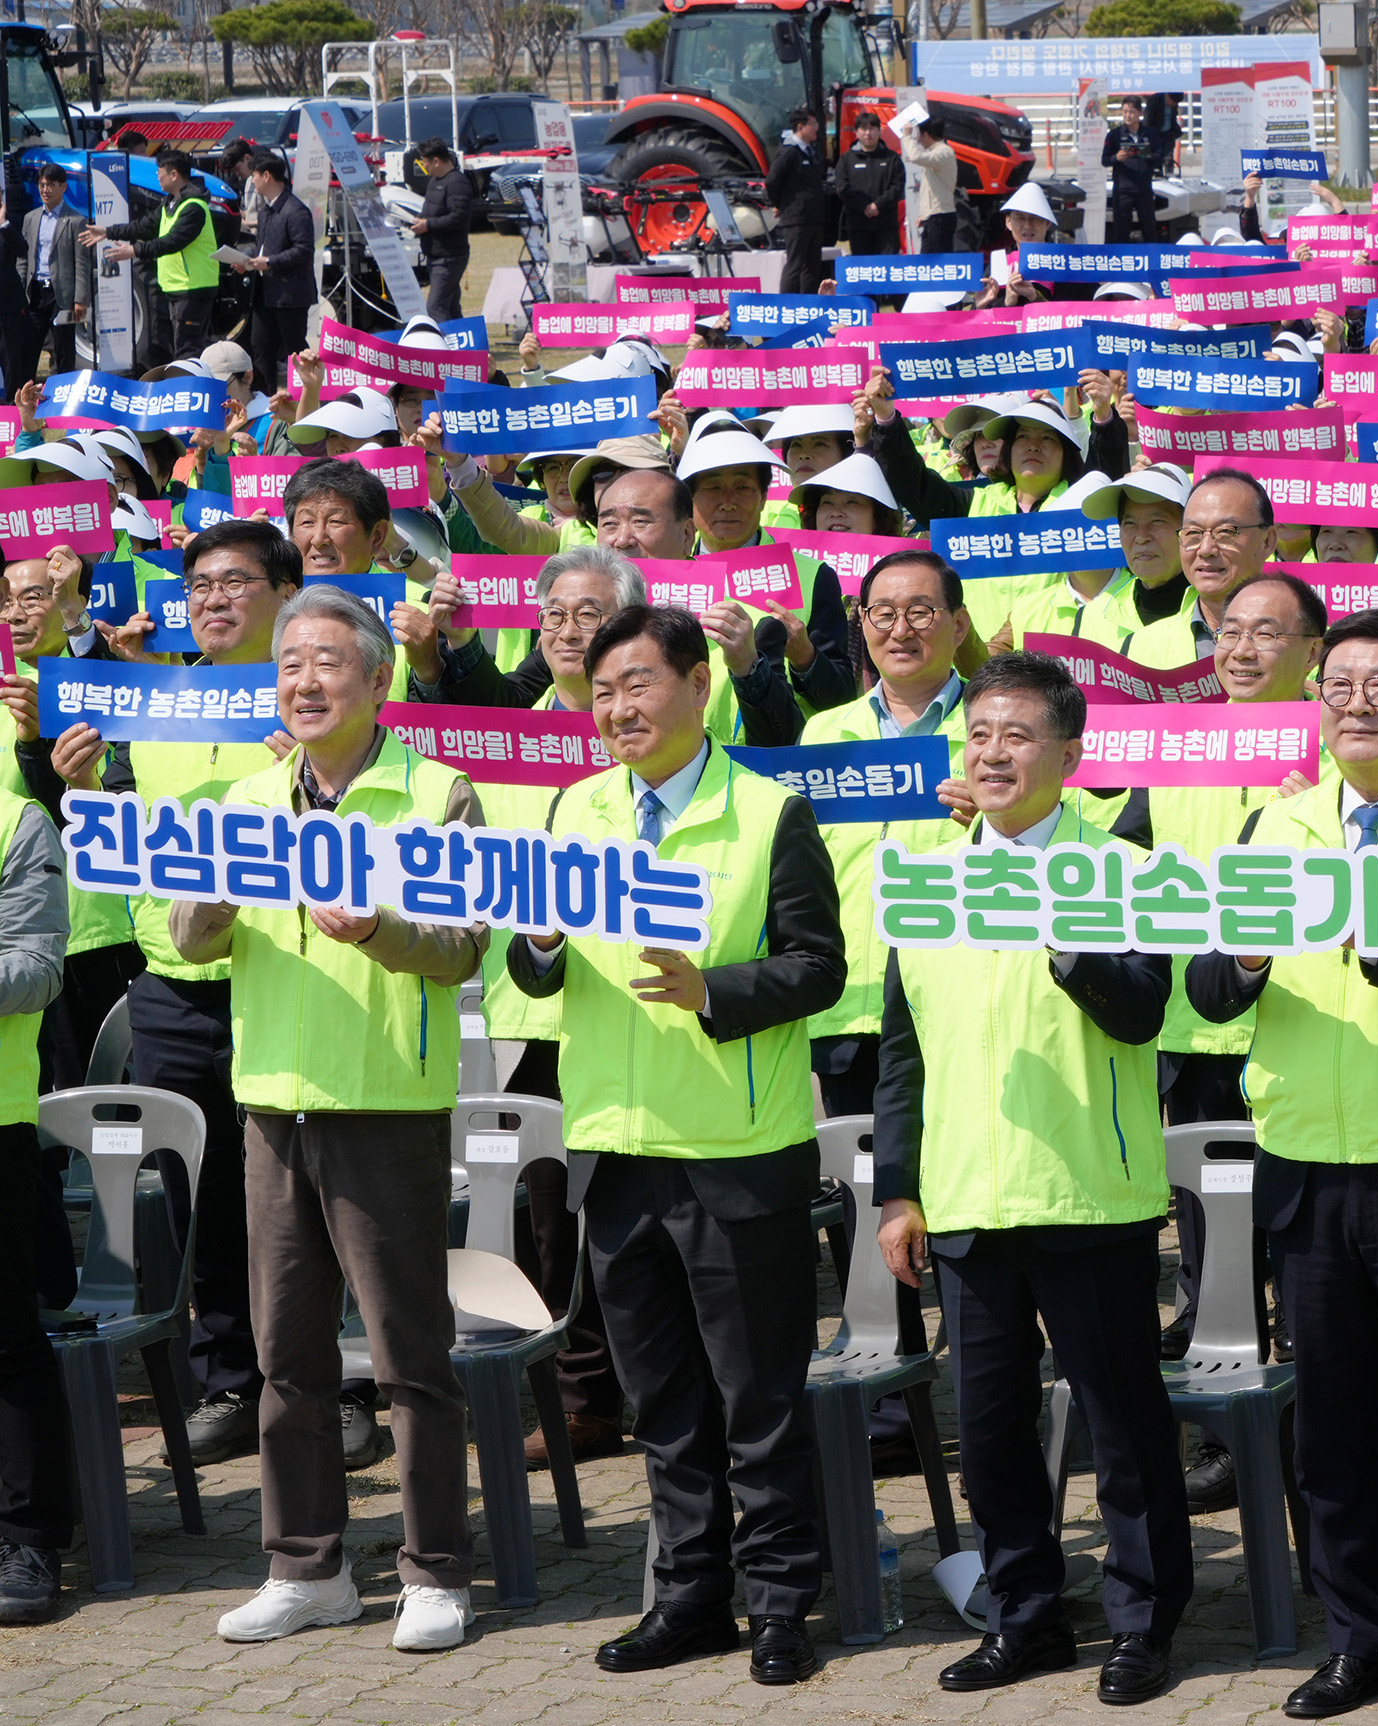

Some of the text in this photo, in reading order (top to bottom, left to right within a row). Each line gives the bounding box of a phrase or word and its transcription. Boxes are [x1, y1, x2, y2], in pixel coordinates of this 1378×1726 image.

[1213, 105, 1240, 114] RT100
[1268, 99, 1297, 108] RT100
[1263, 157, 1318, 171] 농촌일손돕기
[95, 200, 114, 216] MT7
[846, 265, 971, 282] 행복한 농촌일손돕기
[1027, 254, 1148, 271] 행복한 농촌일손돕기
[1174, 283, 1336, 312] 농업에 희망을! 농촌에 행복을!
[539, 317, 571, 333] 농업에
[574, 317, 613, 333] 희망을!
[654, 314, 689, 332] 행복을!
[737, 305, 779, 323] 행복한
[323, 337, 435, 378] 농업에 희망을! 농촌에
[896, 346, 1074, 380] 행복한 농촌일손돕기
[711, 364, 861, 389] 희망을! 농촌에 행복을!
[1137, 367, 1300, 397] 행복한 농촌일손돕기
[1331, 371, 1374, 393] 농업에
[111, 392, 209, 415] 농촌일손돕기
[443, 395, 637, 433] 행복한 농촌일손돕기
[1174, 426, 1336, 451] 희망을! 농촌에 행복을!
[32, 503, 100, 535] 행복을!
[948, 524, 1120, 560] 행복한 농촌일손돕
[460, 577, 518, 605] 농업에
[732, 564, 791, 597] 행복을!
[58, 682, 277, 718] 행복한 농촌일손돕
[441, 728, 584, 765] 희망을! 농촌에
[1081, 728, 1307, 761] 희망을! 농촌에 행복을!
[71, 800, 703, 941] 진심담아 함께하는
[487, 1145, 510, 1154] 강호동
